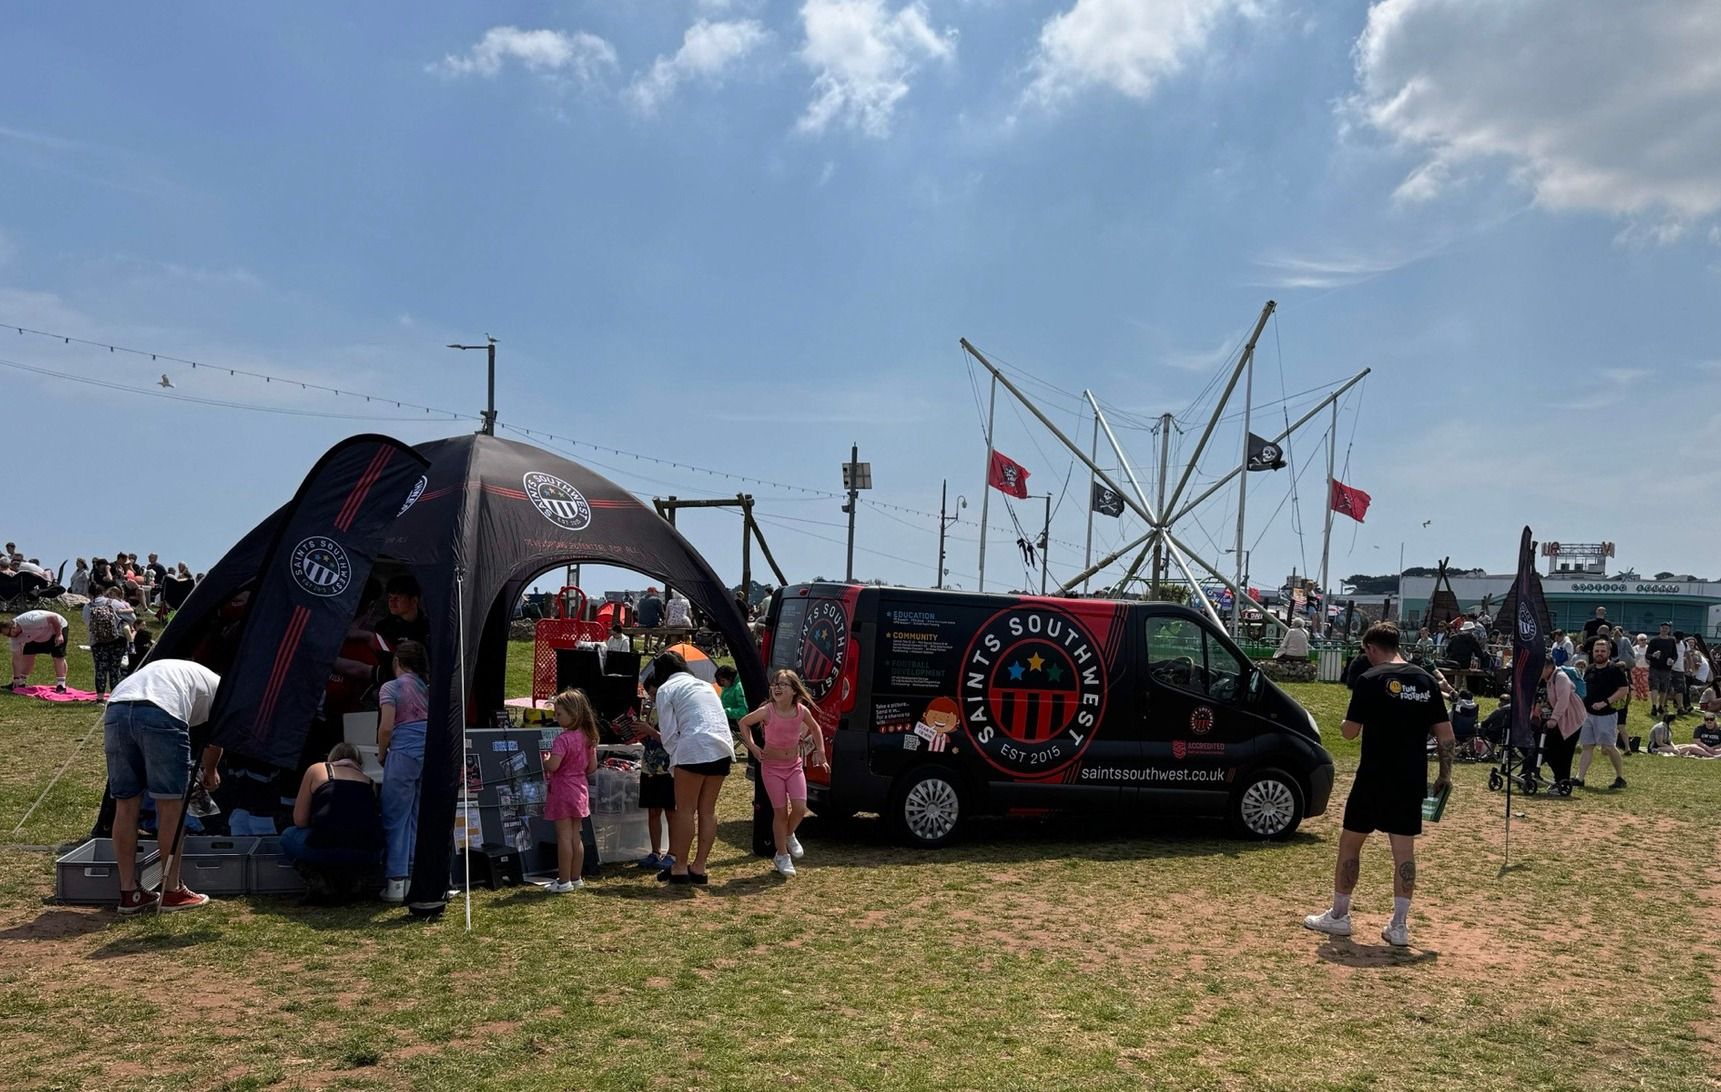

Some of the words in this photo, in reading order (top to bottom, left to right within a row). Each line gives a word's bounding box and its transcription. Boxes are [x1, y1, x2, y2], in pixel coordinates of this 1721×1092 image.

[528, 479, 553, 517] SAINTS
[532, 475, 588, 521] SOUTHWEST
[293, 540, 316, 576] SAINTS
[320, 540, 348, 593] SOUTHWEST
[893, 611, 935, 620] EDUCATION
[820, 603, 845, 697] SOUTHWEST
[892, 632, 938, 641] COMMUNITY
[967, 633, 1001, 744] SAINTS
[1009, 615, 1099, 747] SOUTHWEST
[1400, 690, 1431, 701] FOOTBALL
[1001, 744, 1027, 764] EST
[1030, 745, 1061, 764] 2015
[1081, 766, 1225, 782] saintssouthwest.co.uk
